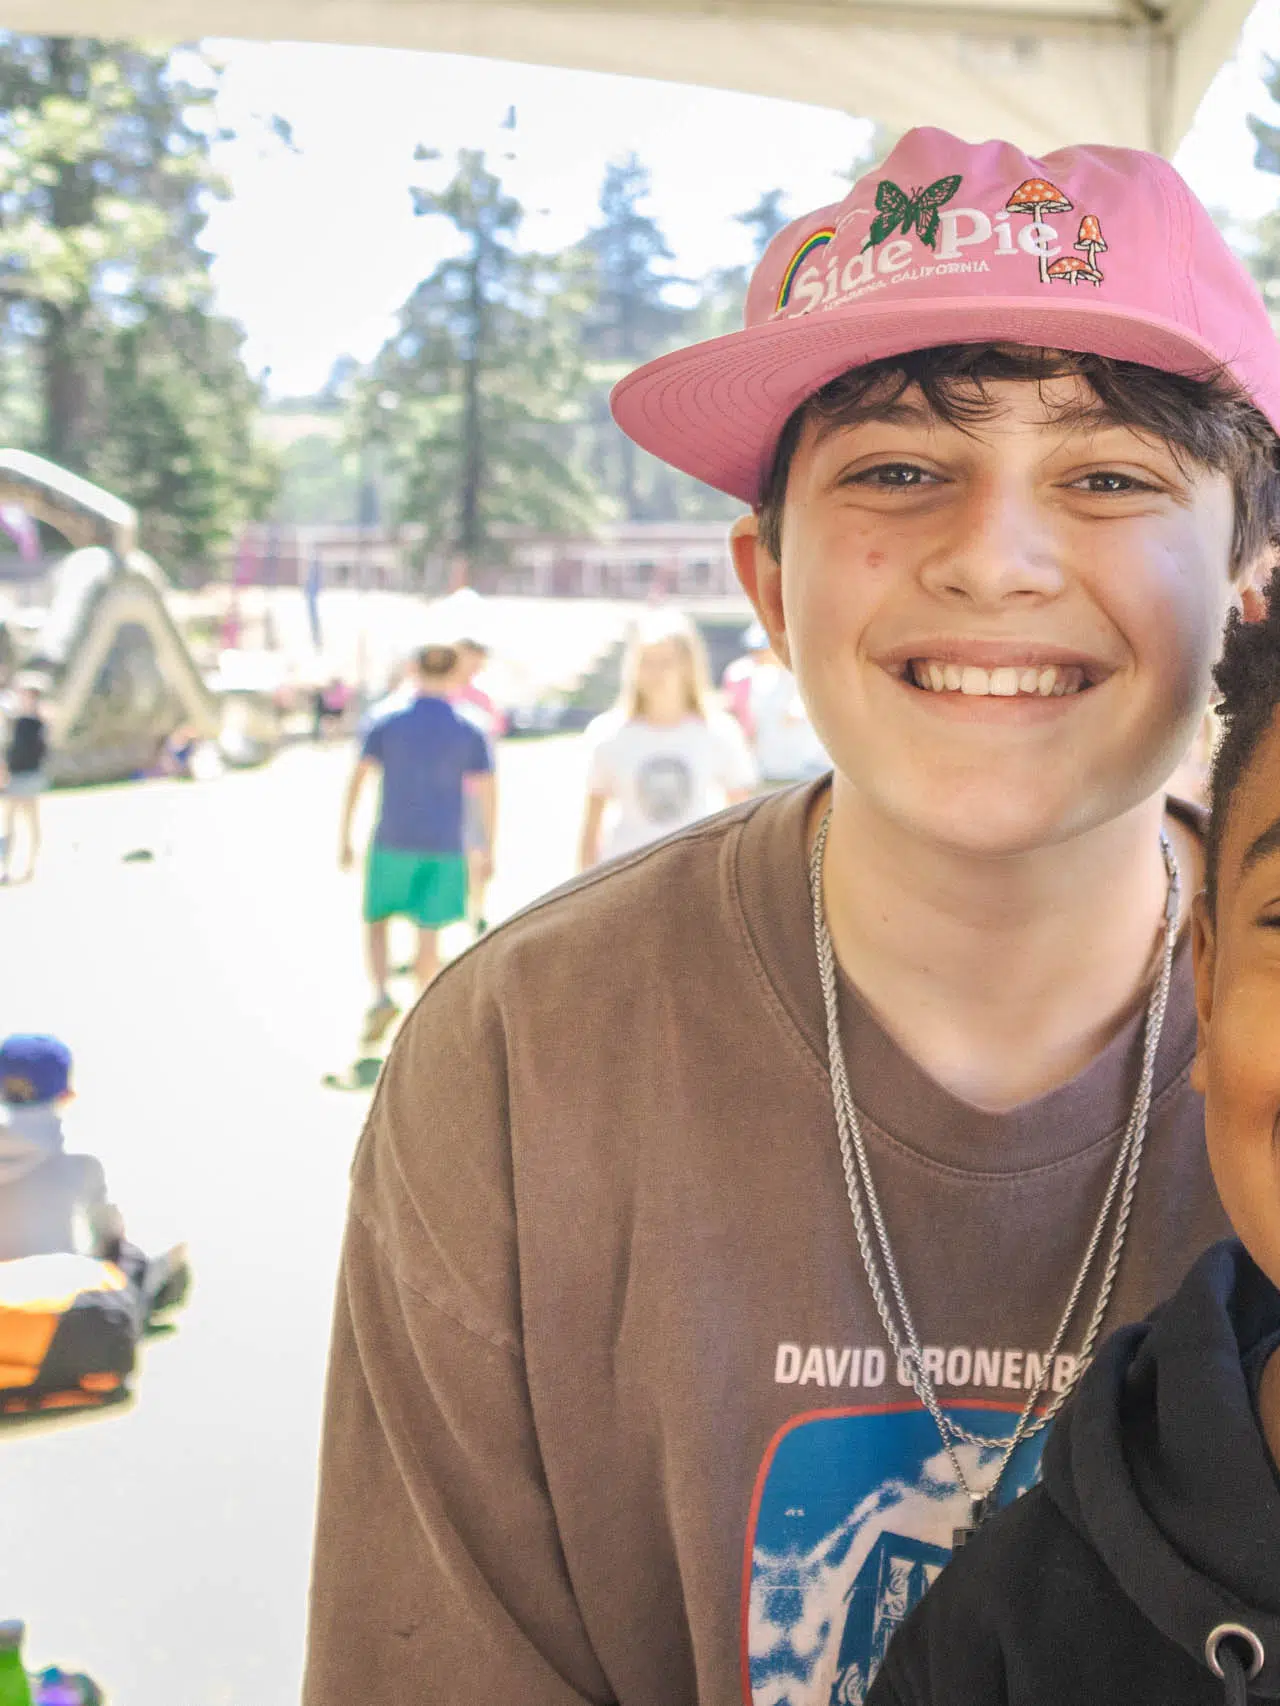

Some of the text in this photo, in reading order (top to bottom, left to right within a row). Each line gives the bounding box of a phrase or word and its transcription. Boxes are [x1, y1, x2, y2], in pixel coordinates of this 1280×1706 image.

[788, 236, 914, 319] Side
[933, 207, 1063, 260] Pie
[891, 260, 991, 284] CALIFORNIA
[775, 1343, 1094, 1393] DAVID CRONENB
